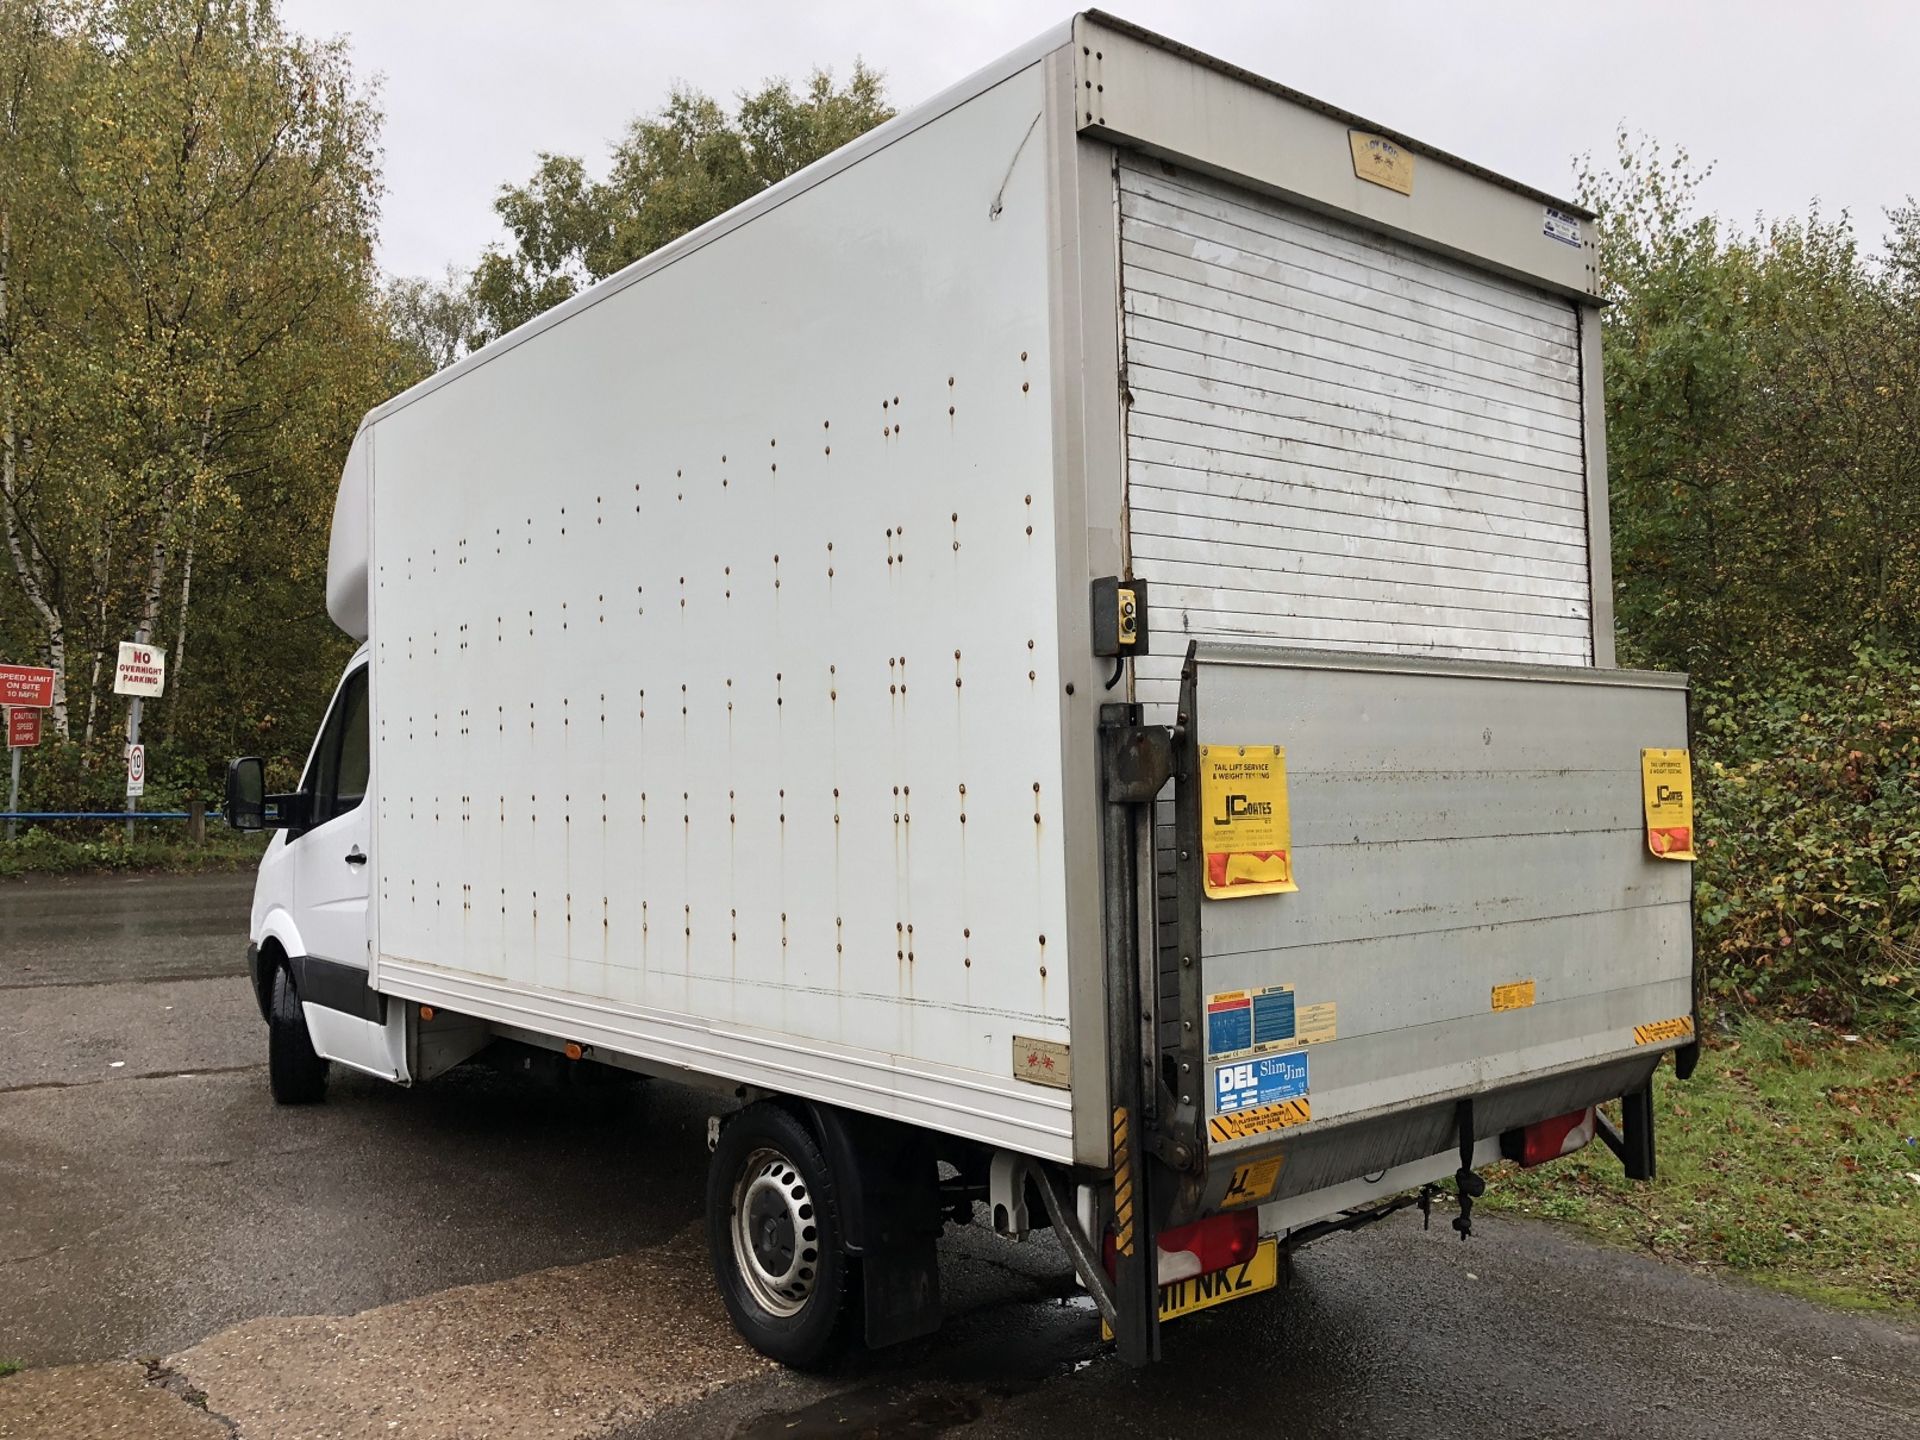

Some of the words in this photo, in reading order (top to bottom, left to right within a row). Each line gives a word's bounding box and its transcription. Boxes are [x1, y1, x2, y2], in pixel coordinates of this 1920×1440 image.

[133, 651, 151, 664] NO
[119, 664, 162, 676] OVERNIGHT
[0, 672, 27, 682] SPEED
[28, 674, 52, 683] LIMIT
[122, 674, 158, 685] PARKING
[6, 681, 20, 689] ON
[21, 682, 41, 691] SITE
[18, 691, 39, 699] MPH
[13, 712, 38, 720] CAUTION
[16, 722, 33, 730] SPEED
[15, 733, 34, 741] RAMPS
[133, 754, 141, 768] 10
[1214, 763, 1227, 771] TAIL
[1229, 763, 1243, 771] LIFT
[1243, 763, 1269, 771] SERVICE
[1218, 772, 1244, 780] WEIGHT
[1244, 772, 1270, 780] TESING
[1219, 1063, 1259, 1093] DEL
[1260, 1059, 1286, 1077] Slim
[1284, 1064, 1305, 1080] Jim
